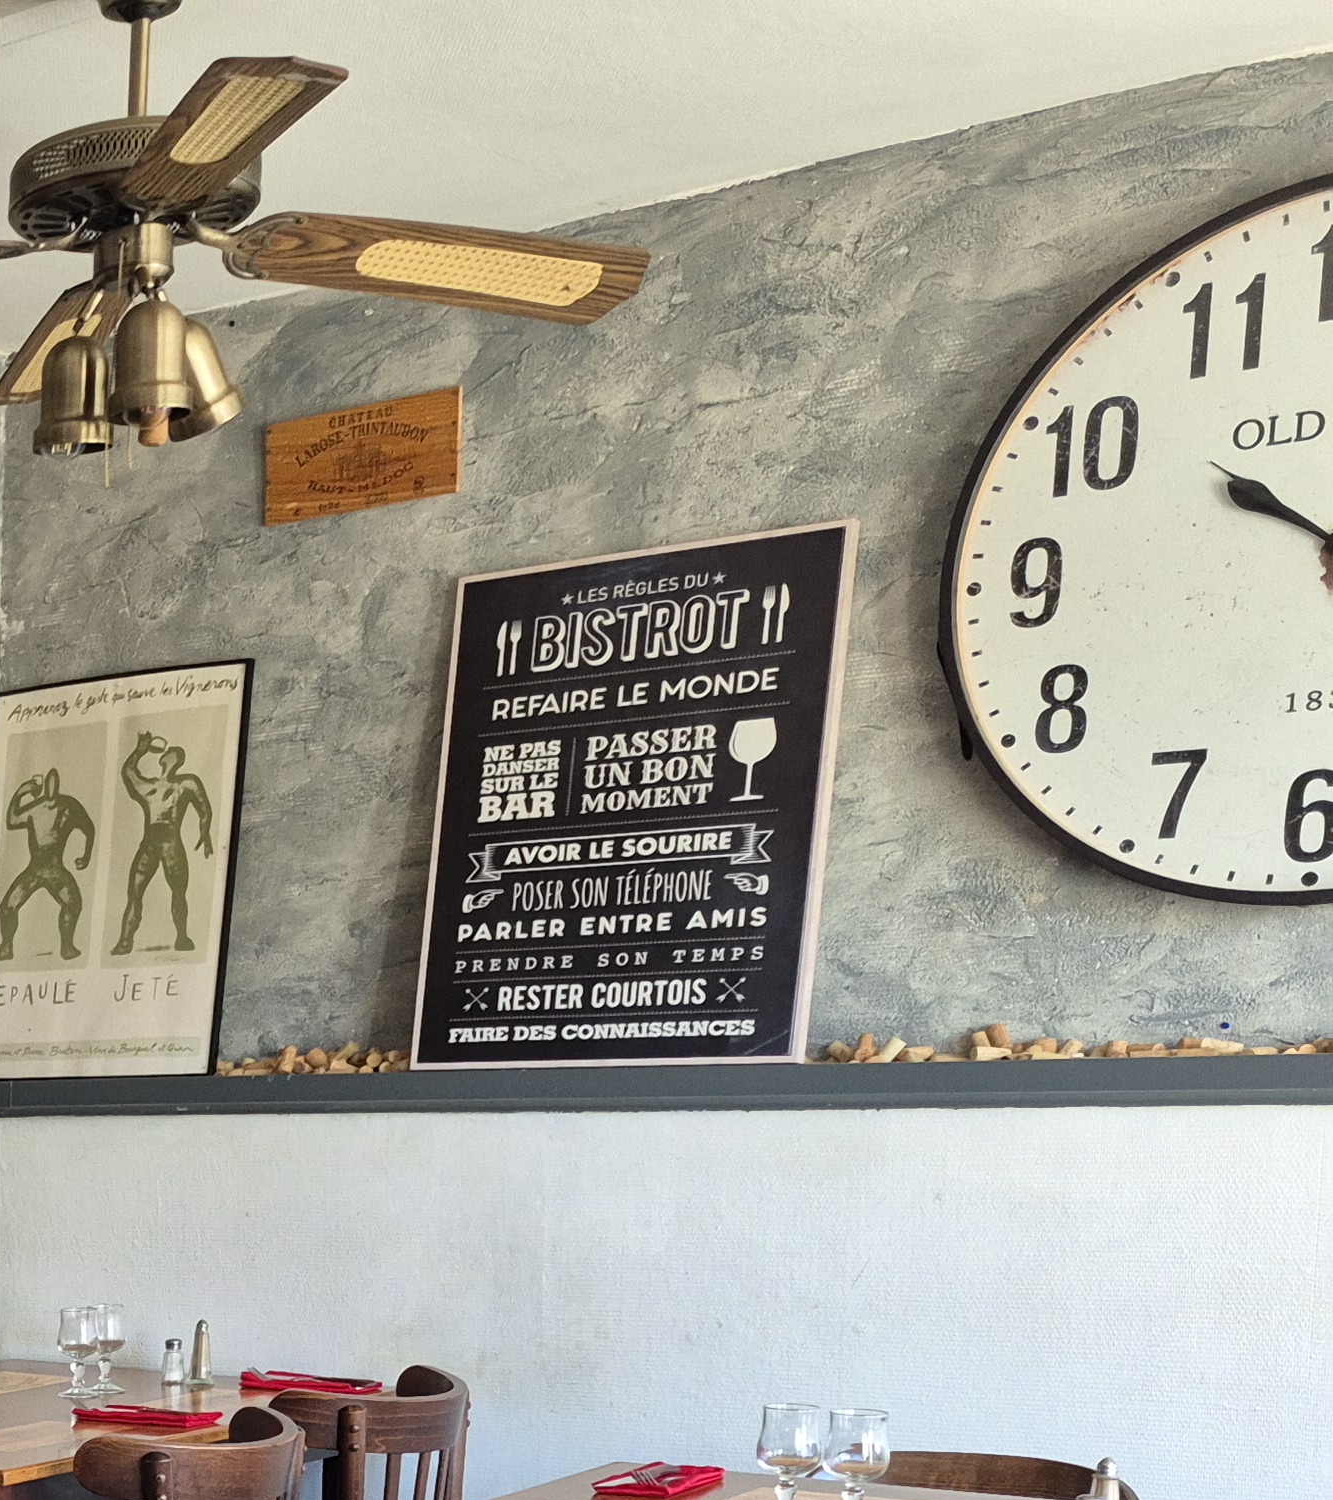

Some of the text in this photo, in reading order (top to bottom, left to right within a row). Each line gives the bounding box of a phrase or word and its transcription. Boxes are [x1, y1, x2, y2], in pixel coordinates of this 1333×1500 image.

[1183, 272, 1266, 379] 11
[329, 406, 394, 429] CHATEAU
[1232, 410, 1325, 450] OLD
[1045, 396, 1139, 498] 10
[577, 586, 608, 604] LES
[684, 572, 709, 589] DU
[1009, 537, 1063, 628] 9
[530, 588, 750, 673] BISTROT
[492, 667, 780, 721] REFAIRE LE MONDE
[1034, 664, 1088, 753] 8
[483, 739, 561, 763] NE PAS
[585, 724, 717, 761] PASSER
[480, 773, 558, 794] SUR LE
[482, 757, 560, 777] DANSER
[584, 753, 716, 789] UN BON
[477, 791, 555, 823] BAR
[579, 782, 713, 814] MOMENT
[1152, 748, 1208, 840] 7
[1284, 768, 1333, 863] 6
[504, 831, 732, 865] AVOIR LE SOURIRE
[512, 868, 713, 912] POSER SON TÉLÉPHONE
[457, 907, 768, 942] PARLER ENTRE AMIS
[454, 946, 764, 974] PRENDRE SON TEMPS
[497, 978, 707, 1012] RESTER COURTOIS
[448, 1019, 755, 1043] FAIRE DES CONNAISSANCES
